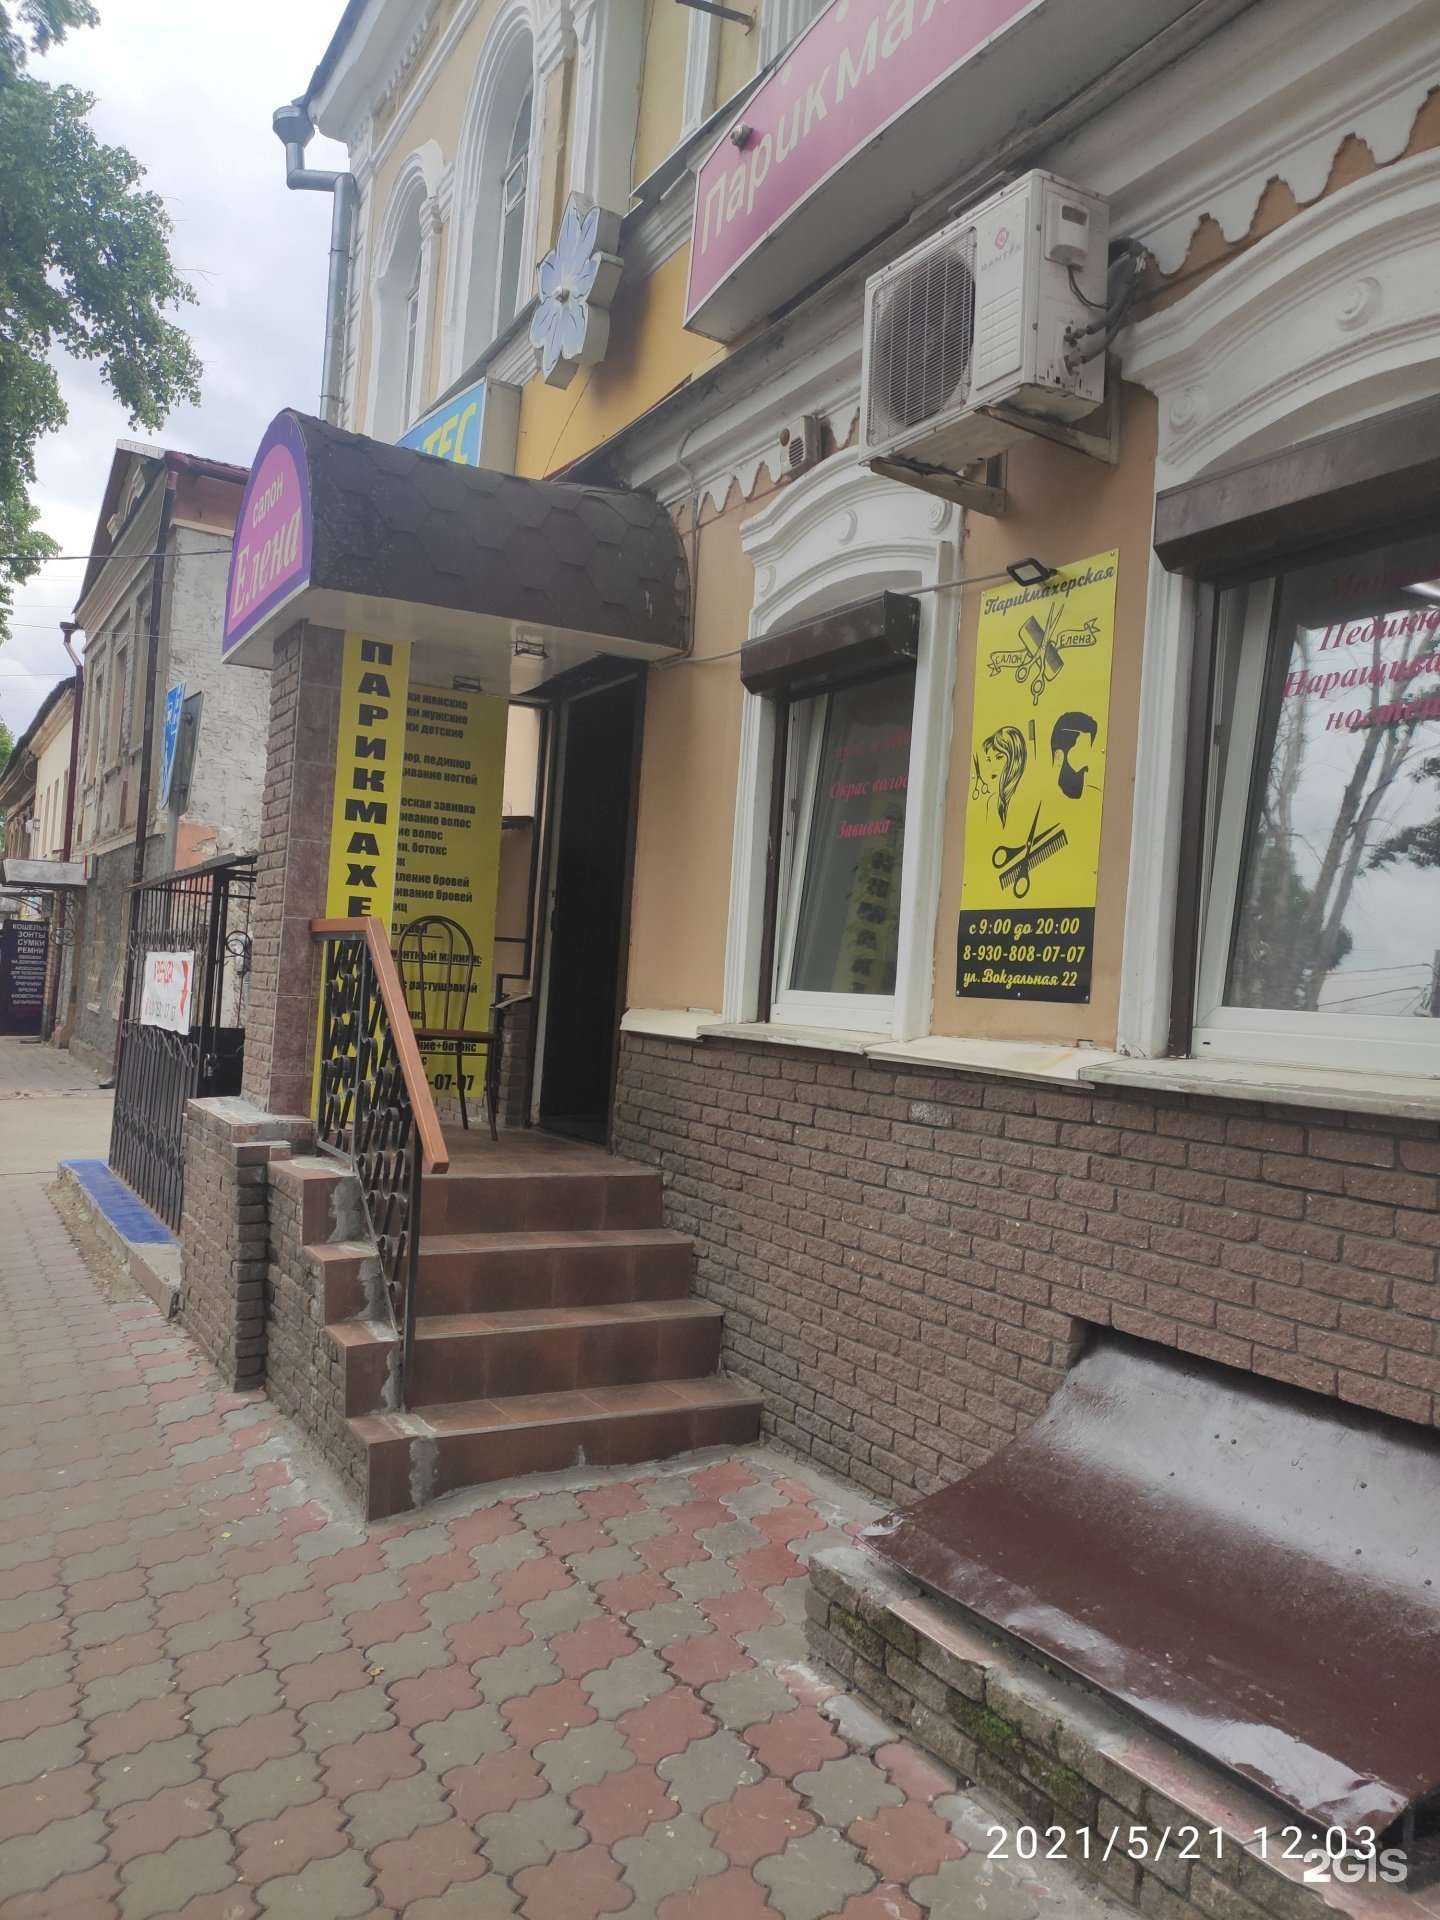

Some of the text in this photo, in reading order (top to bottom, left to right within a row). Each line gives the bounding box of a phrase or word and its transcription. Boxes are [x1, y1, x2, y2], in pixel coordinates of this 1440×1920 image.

[231, 505, 302, 619] Елена
[984, 566, 1115, 616] Парикмахерская
[1060, 633, 1092, 647] Елена
[344, 639, 395, 917] ПАРИКМАХЕ
[979, 918, 1012, 935] 9:00
[1013, 924, 1032, 941] до
[1035, 918, 1080, 935] 20:00
[17, 938, 46, 946] СУМКИ
[17, 946, 44, 954] РЕМНИ
[963, 945, 1086, 963] 8-930-808-07-07
[1061, 971, 1077, 987] 22
